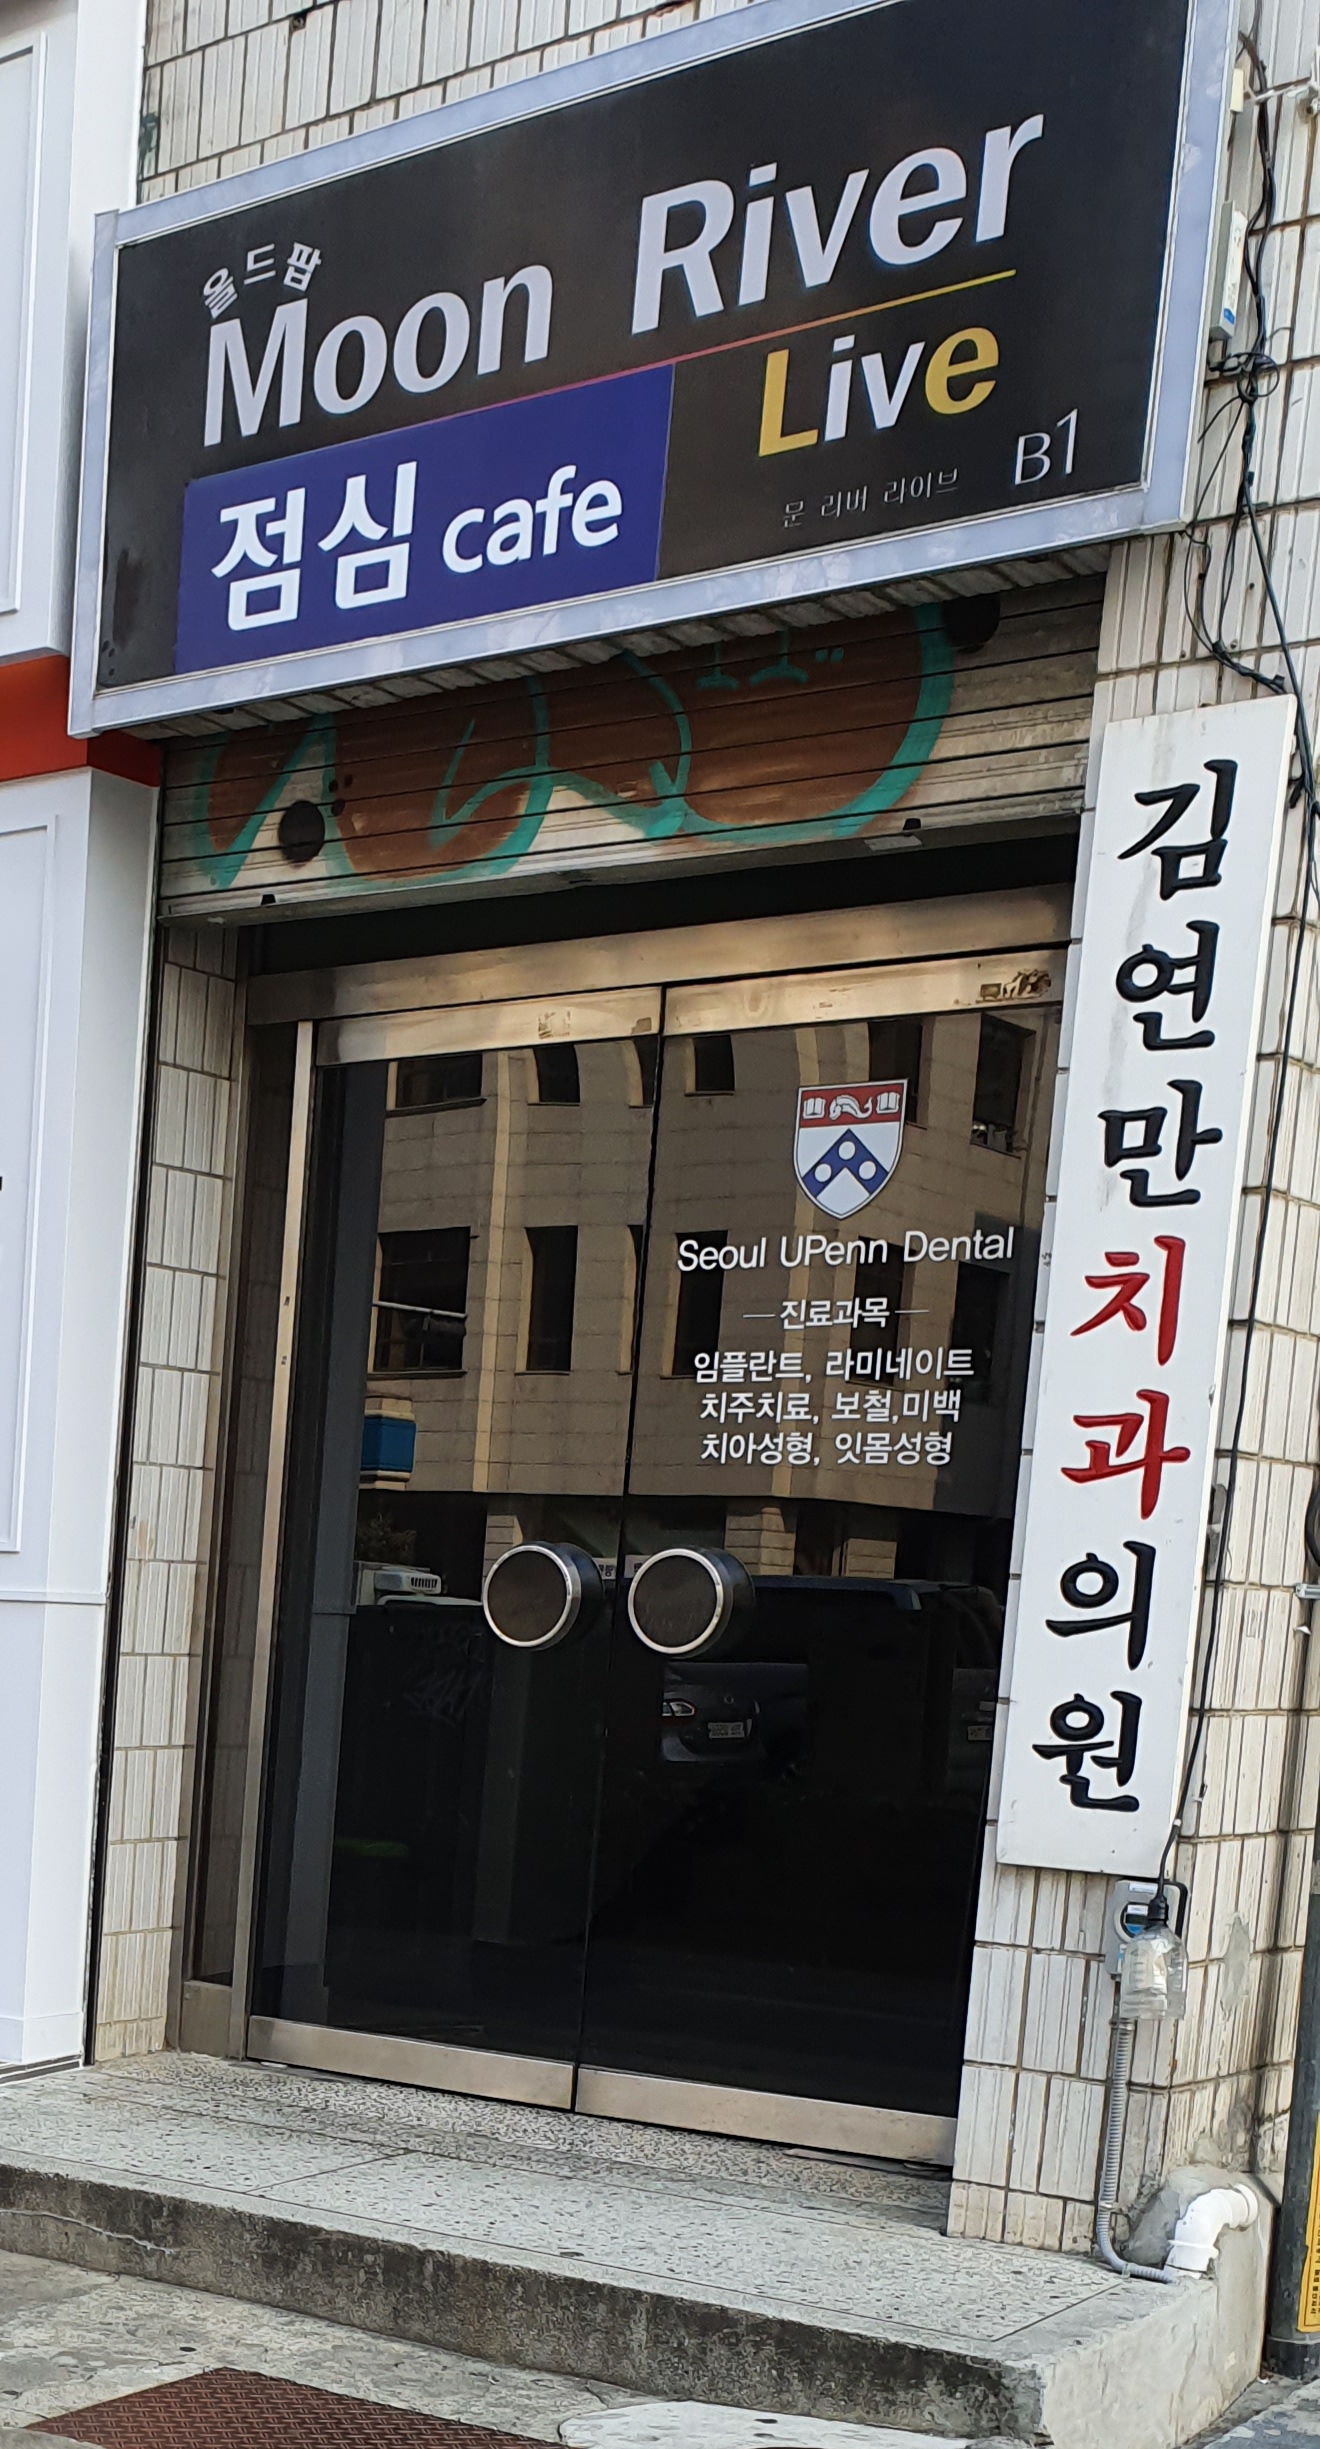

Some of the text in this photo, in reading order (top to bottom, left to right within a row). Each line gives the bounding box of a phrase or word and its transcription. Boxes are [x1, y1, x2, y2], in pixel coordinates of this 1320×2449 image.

[203, 242, 322, 319] 올드팝
[204, 114, 1044, 447] Moon River
[757, 327, 999, 457] Live
[1014, 408, 1078, 485] B1
[784, 467, 959, 528] 문 리버 라이브
[211, 461, 622, 631] 점심 cafe
[677, 1226, 1014, 1272] Seoul UPenn Dental
[780, 1297, 890, 1330] 진료과목
[694, 1346, 974, 1383] 임플란트, 라미네이트
[700, 1391, 819, 1425] 치주치료,
[700, 1431, 952, 1466] 치아성형, 잇몸성형
